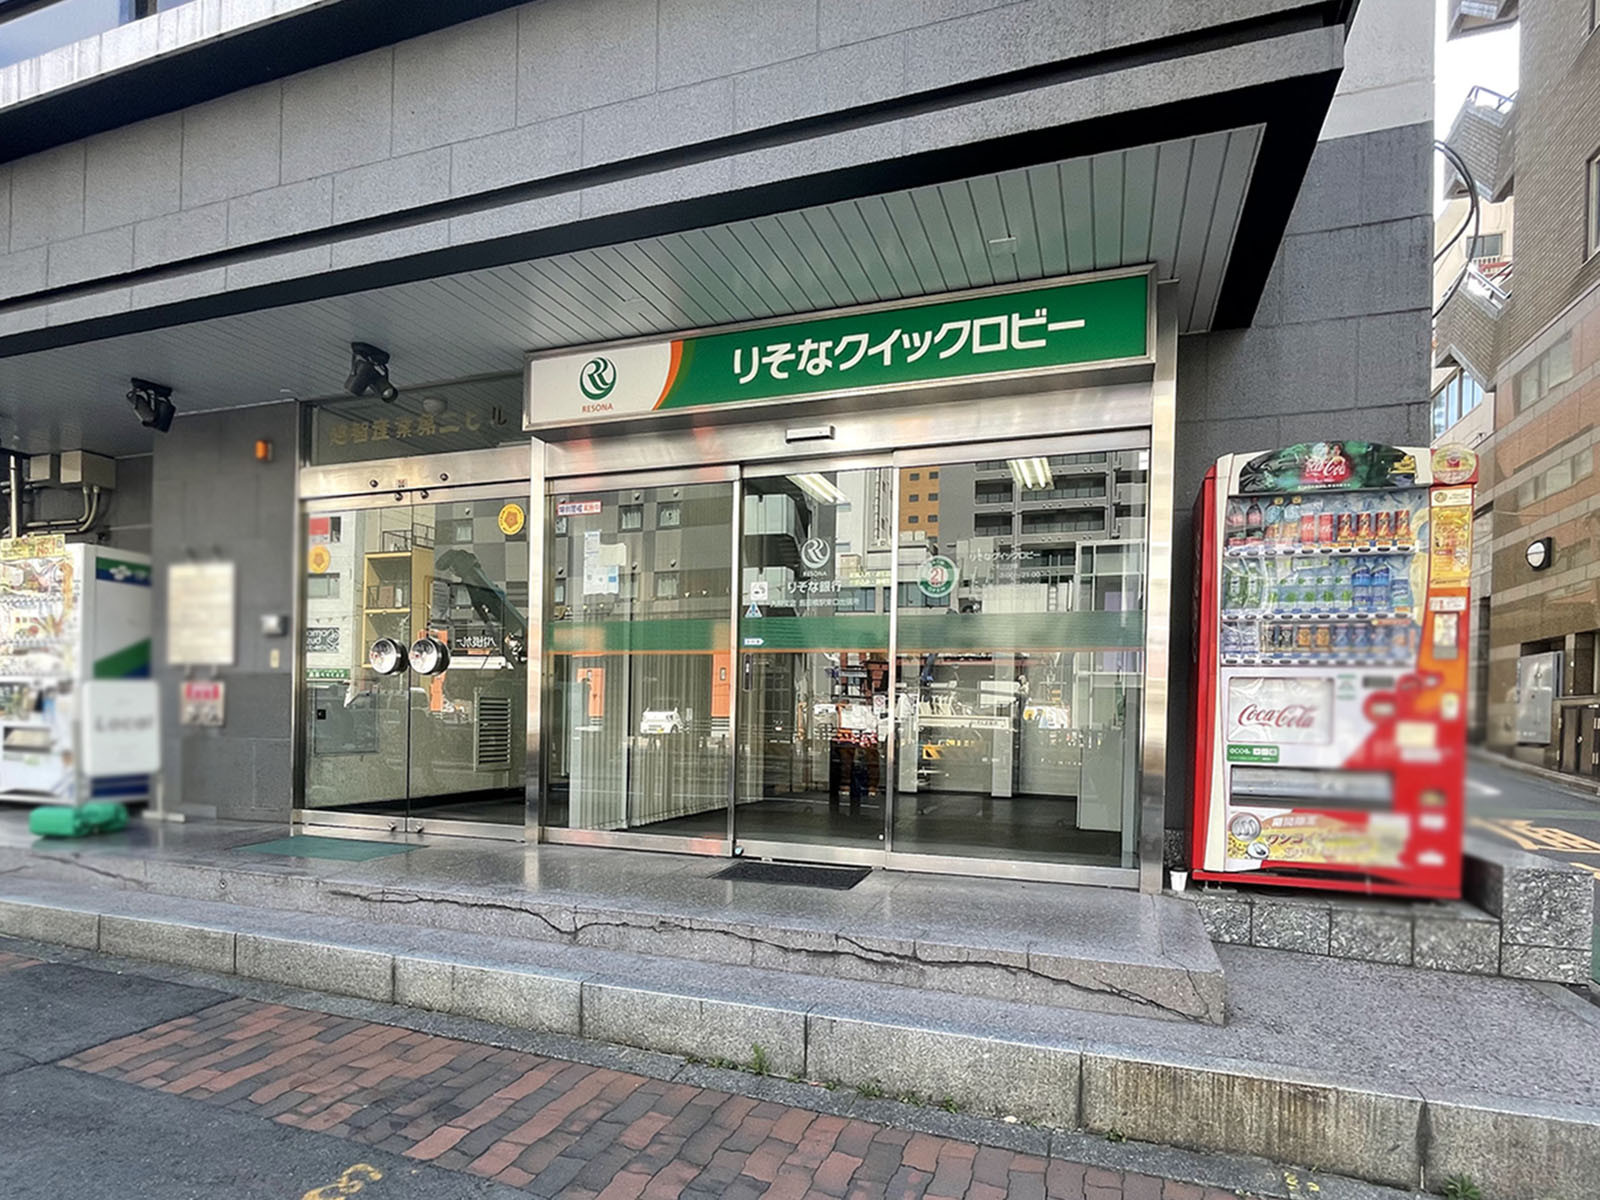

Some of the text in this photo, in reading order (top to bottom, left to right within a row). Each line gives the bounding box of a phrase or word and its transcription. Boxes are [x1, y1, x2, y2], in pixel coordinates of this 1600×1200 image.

[733, 308, 1086, 385] りそなクイックロビー
[582, 403, 614, 413] RESONA
[787, 580, 842, 594] りそな銀行
[1237, 703, 1318, 728] Coca-Cola
